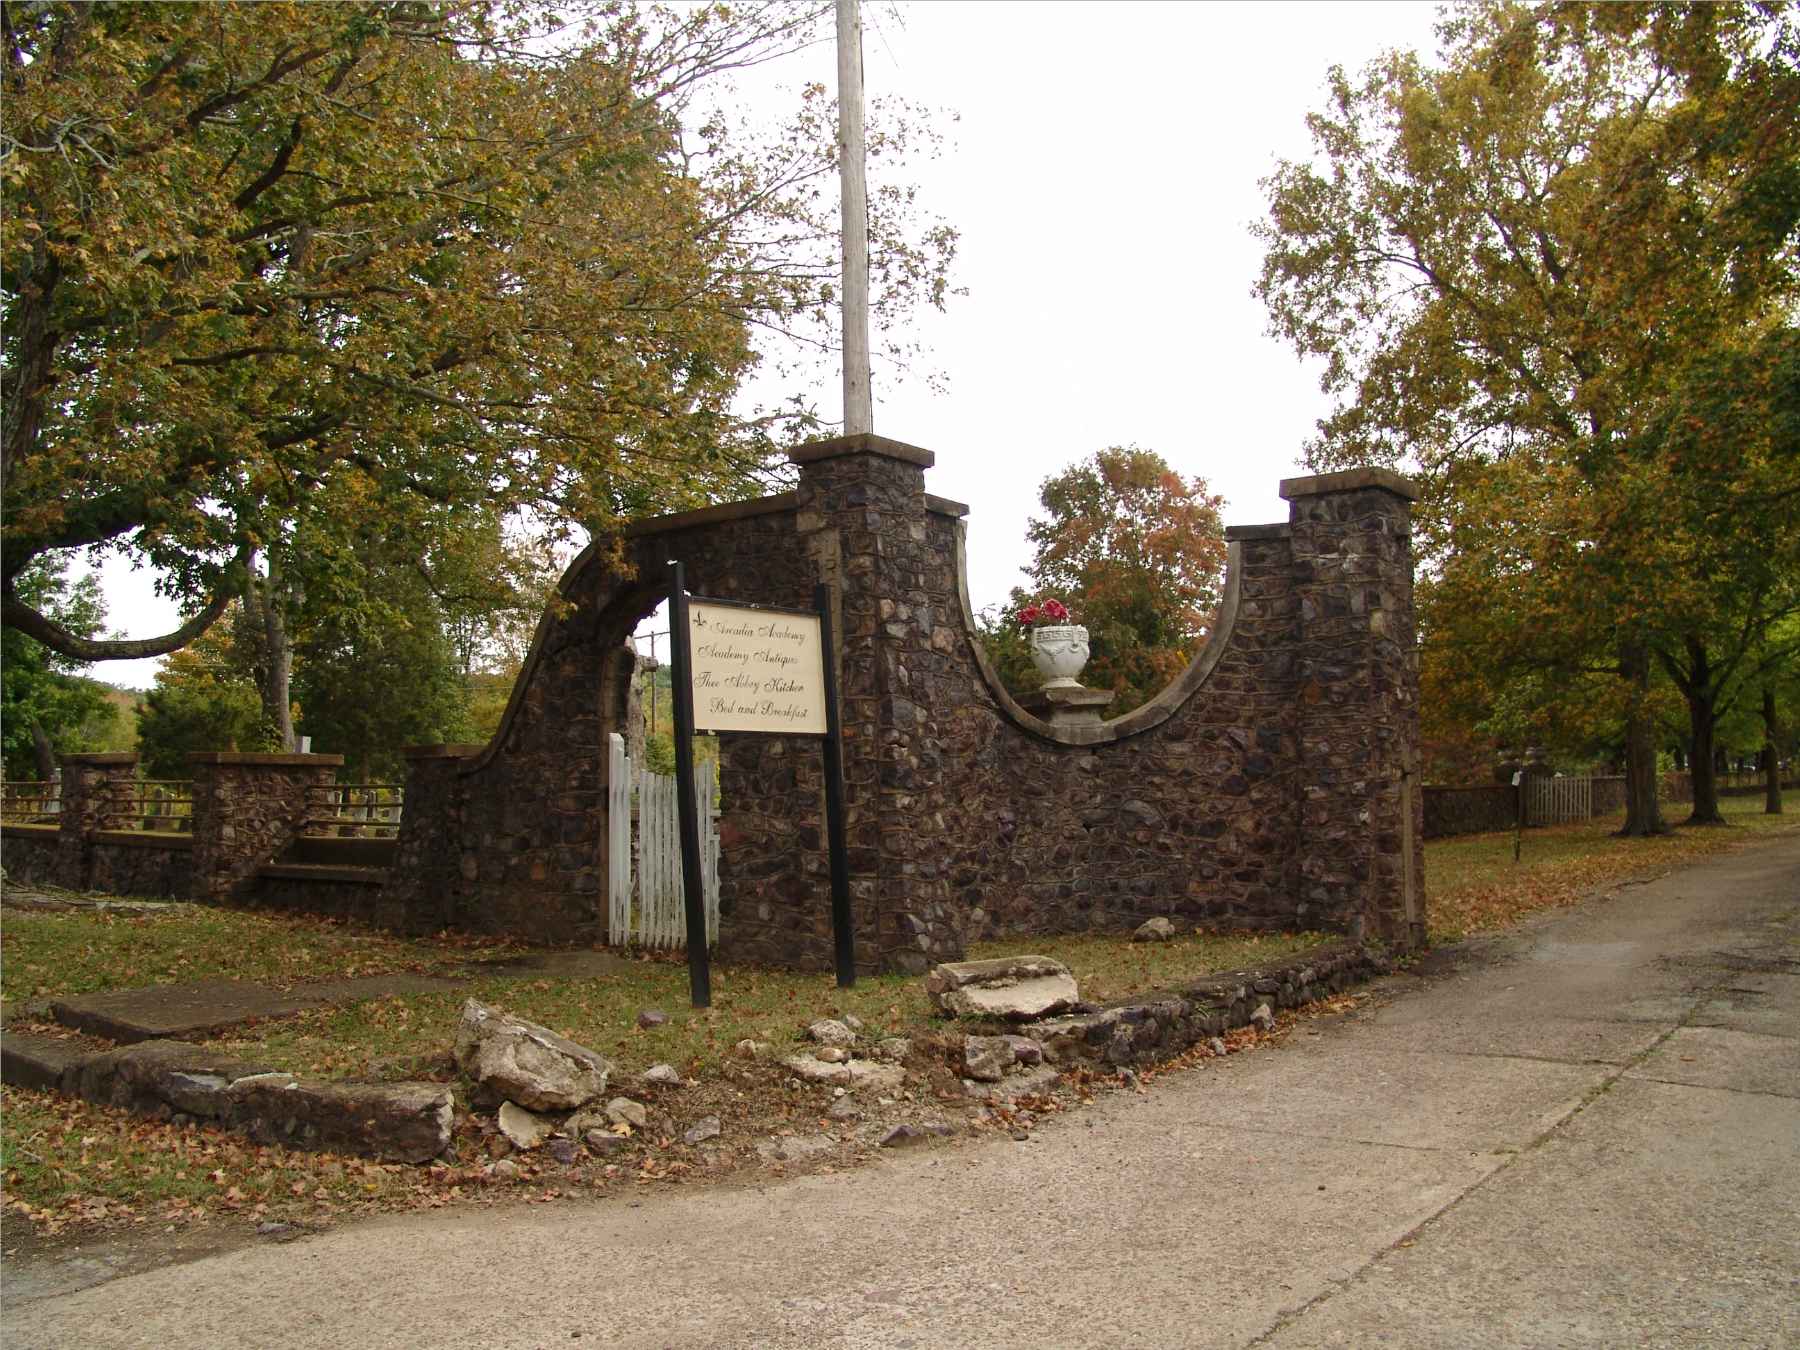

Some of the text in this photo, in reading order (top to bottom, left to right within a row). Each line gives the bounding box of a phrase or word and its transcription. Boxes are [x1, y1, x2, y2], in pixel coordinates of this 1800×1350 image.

[710, 622, 806, 646] Arcadia Academy
[697, 644, 749, 665] Academy
[764, 677, 804, 693] Kitchen
[710, 698, 808, 720] Bed and Breakfast
